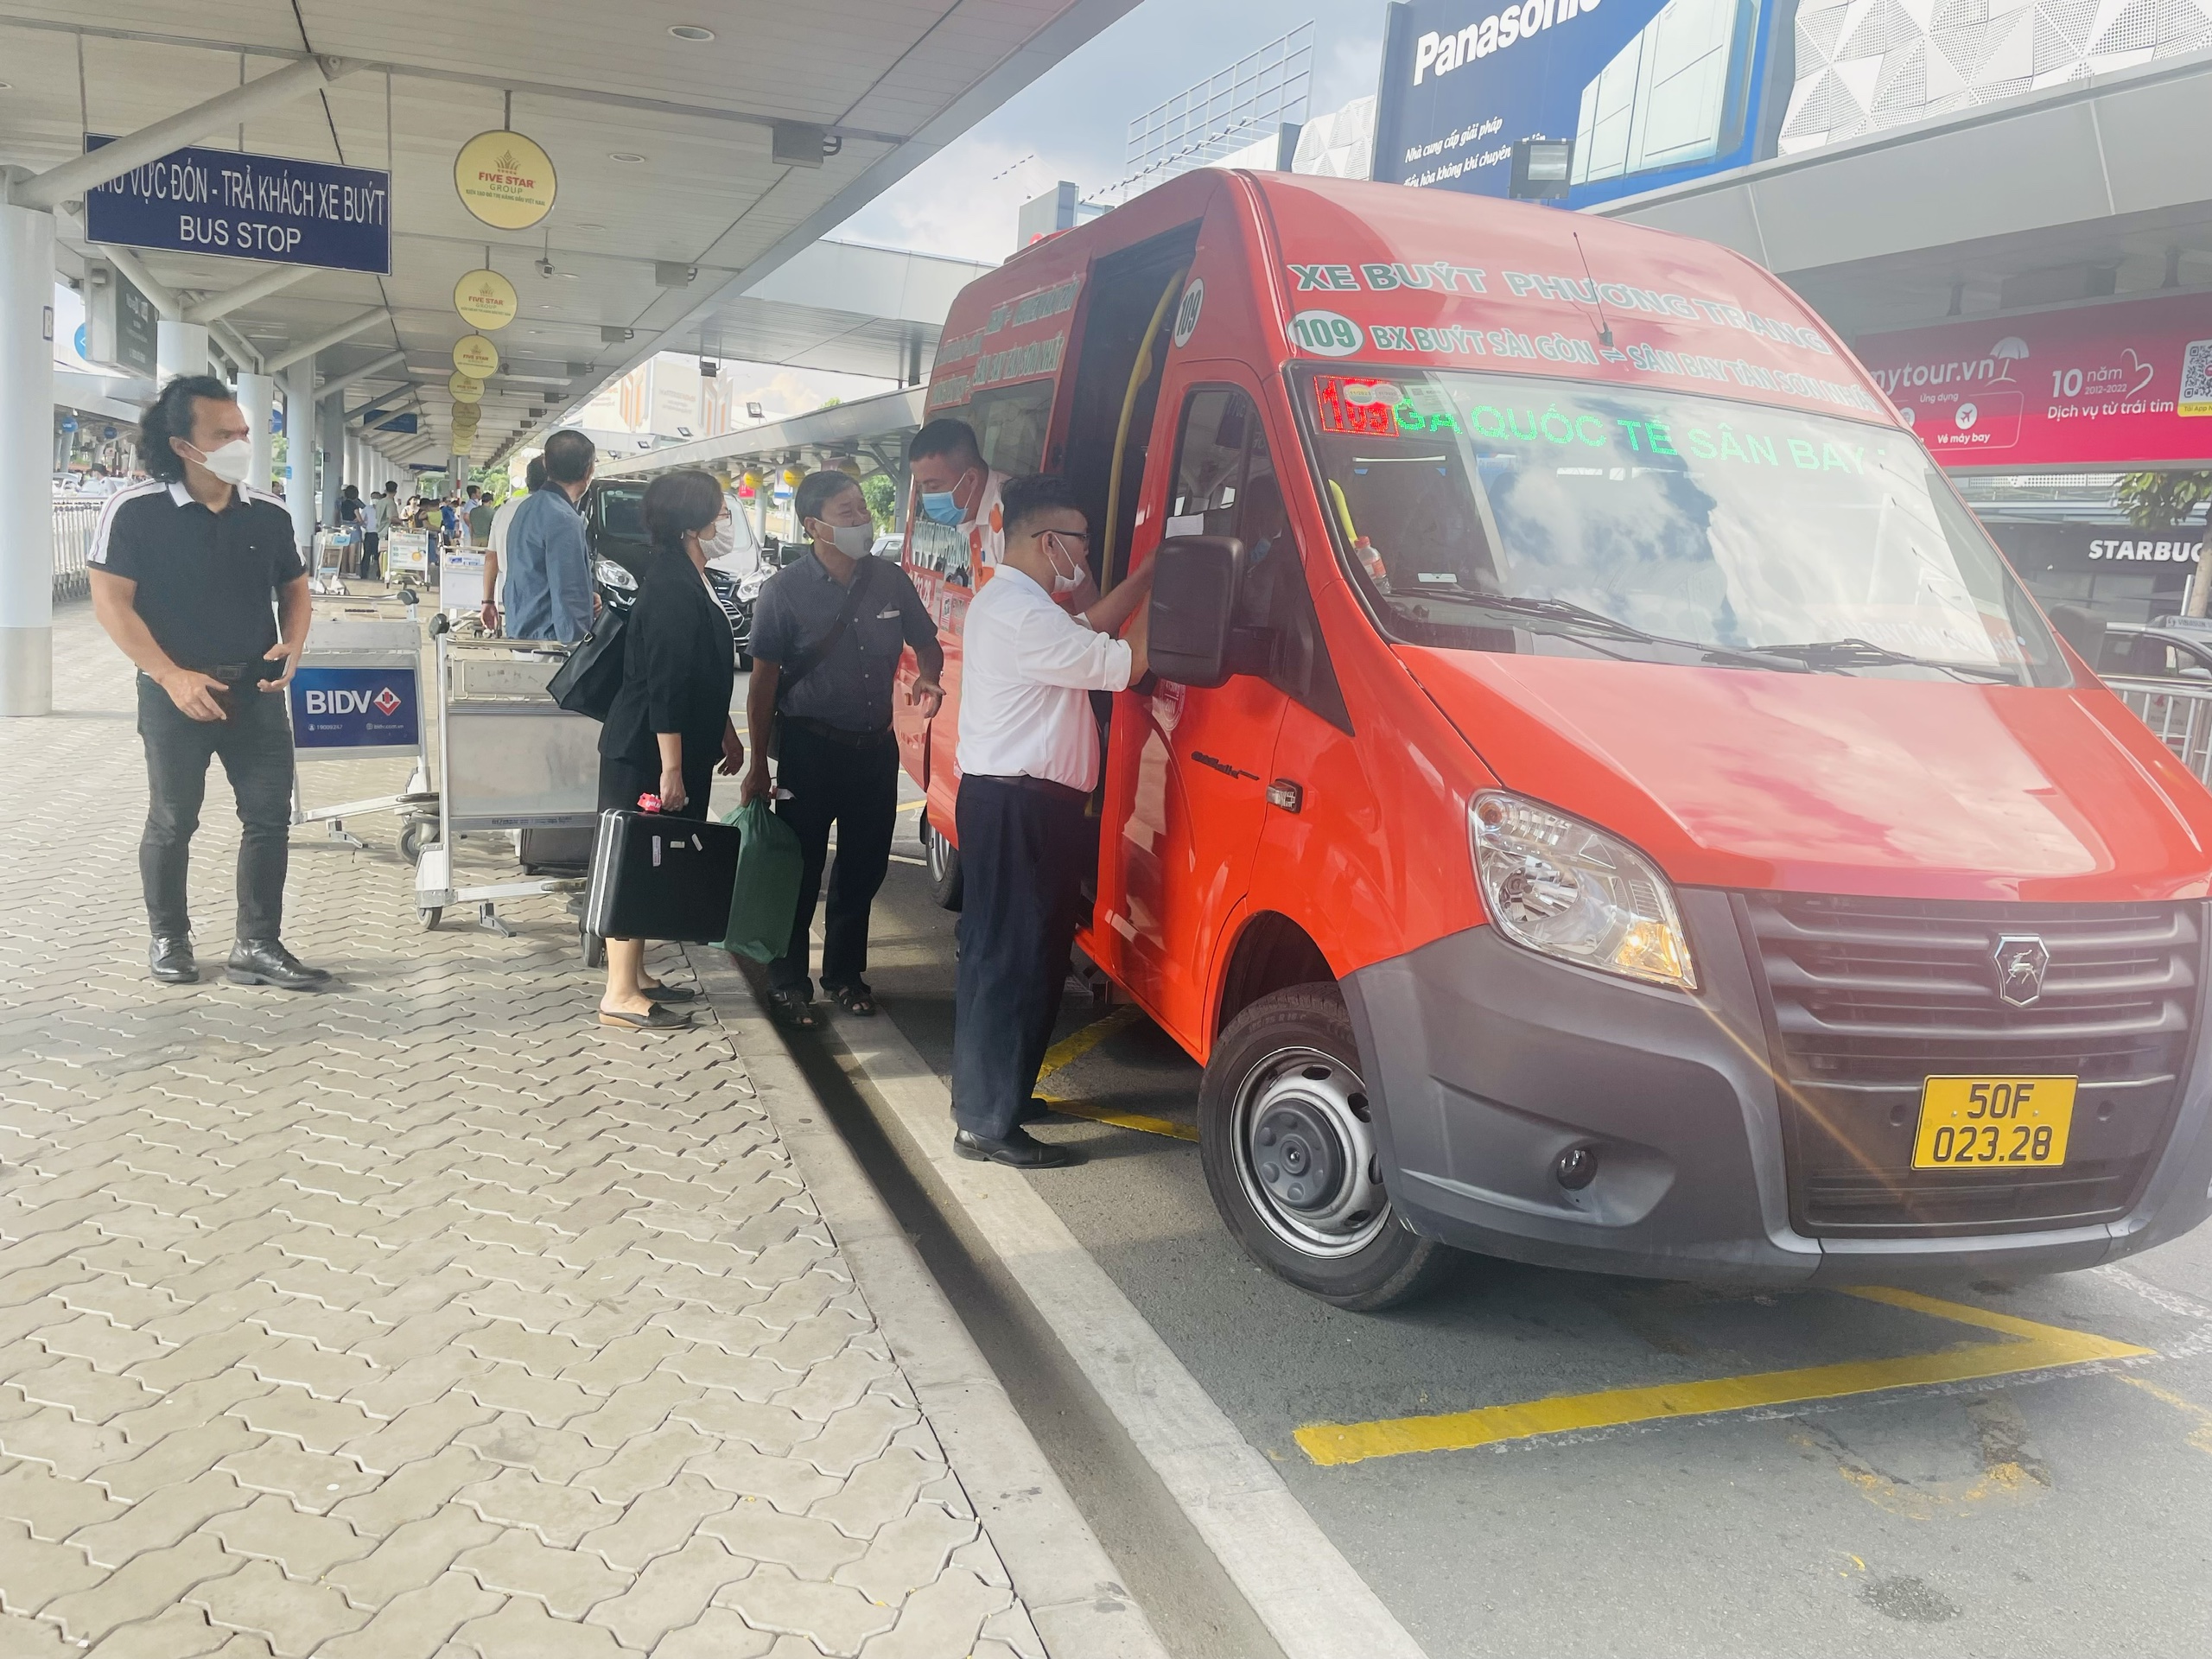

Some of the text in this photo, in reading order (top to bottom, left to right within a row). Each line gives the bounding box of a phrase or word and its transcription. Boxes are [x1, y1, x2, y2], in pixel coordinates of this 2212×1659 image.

[1405, 147, 1421, 163] Nhà
[1423, 139, 1444, 157] cung
[1478, 116, 1503, 140] pháp
[1436, 162, 1464, 181] không
[1464, 151, 1478, 173] khí
[1478, 144, 1512, 168] chuyên
[171, 158, 207, 203] ĐÓN
[221, 164, 255, 210] TRẢ
[258, 168, 314, 217] KHÁCH
[318, 182, 340, 220] XE
[344, 181, 385, 226] BUÝT
[479, 171, 534, 188] FIVE STAR
[490, 183, 523, 194] GROUP
[180, 215, 302, 253] BUS STOP
[486, 297, 504, 306] STAR
[1176, 289, 1202, 336] 109
[1287, 262, 1834, 355] XE BUÝT PHƯƠNG TRANG
[1295, 318, 1357, 348] 109
[1370, 325, 1414, 351] BX
[1413, 324, 1486, 355] BUÝT
[1488, 328, 1537, 359] SÀI
[1535, 333, 1599, 365] GÒN
[1627, 343, 1683, 375] SÂN
[1678, 353, 1729, 382] BAY
[1726, 359, 1777, 393] TÂN
[1771, 370, 1828, 403] SƠN
[1937, 392, 1959, 404] dụng
[2052, 366, 2123, 397] 10 năm
[2084, 383, 2127, 395] 2012-2022
[2047, 398, 2174, 422] Dịch vụ từ trái tim
[1393, 397, 1463, 434] GA
[1471, 404, 1607, 448] QUỐC
[1617, 415, 1678, 455] TẾ
[1688, 422, 1779, 467] SÂN
[1787, 437, 1866, 475] BAY
[1950, 434, 1970, 445] máy
[1972, 432, 1991, 443] bay
[306, 690, 372, 715] BIDV
[1967, 1084, 2035, 1119] 50F
[1933, 1125, 2053, 1163] 023.28
